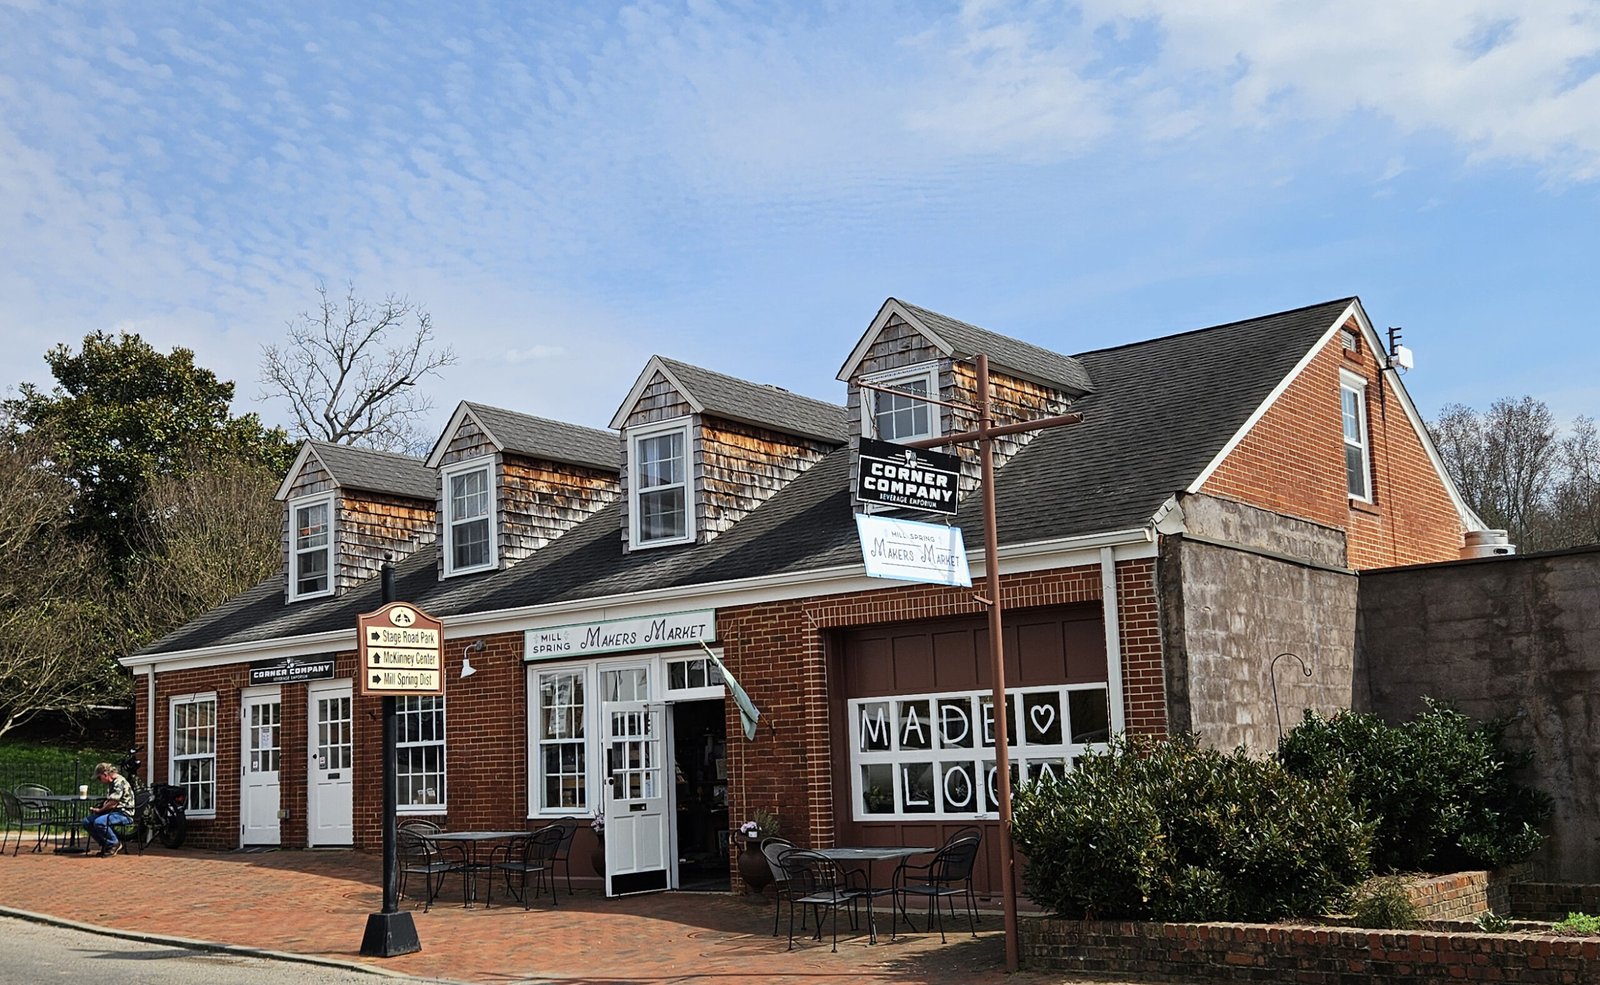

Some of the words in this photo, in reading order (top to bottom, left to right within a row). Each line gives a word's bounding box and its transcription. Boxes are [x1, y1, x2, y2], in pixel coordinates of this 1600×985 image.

[871, 462, 948, 488] CORNER
[864, 476, 953, 502] COMPANY
[879, 493, 908, 503] BEVERAGE
[909, 497, 937, 508] EMPORIUM
[891, 531, 907, 540] MILL
[909, 533, 936, 543] SPRING
[382, 629, 402, 645] Stage
[403, 630, 419, 644] Road
[420, 631, 435, 644] Park
[541, 632, 562, 643] MILL
[532, 642, 571, 655] SPRING
[383, 651, 415, 666] McKinney
[415, 652, 436, 665] Center
[253, 669, 287, 678] CORNER
[289, 665, 330, 675] COMPANY
[383, 672, 396, 685] Mill
[397, 672, 418, 688] Spring
[419, 673, 432, 686] Dist
[861, 703, 1008, 749] MADE
[904, 762, 1084, 807] LOCA
